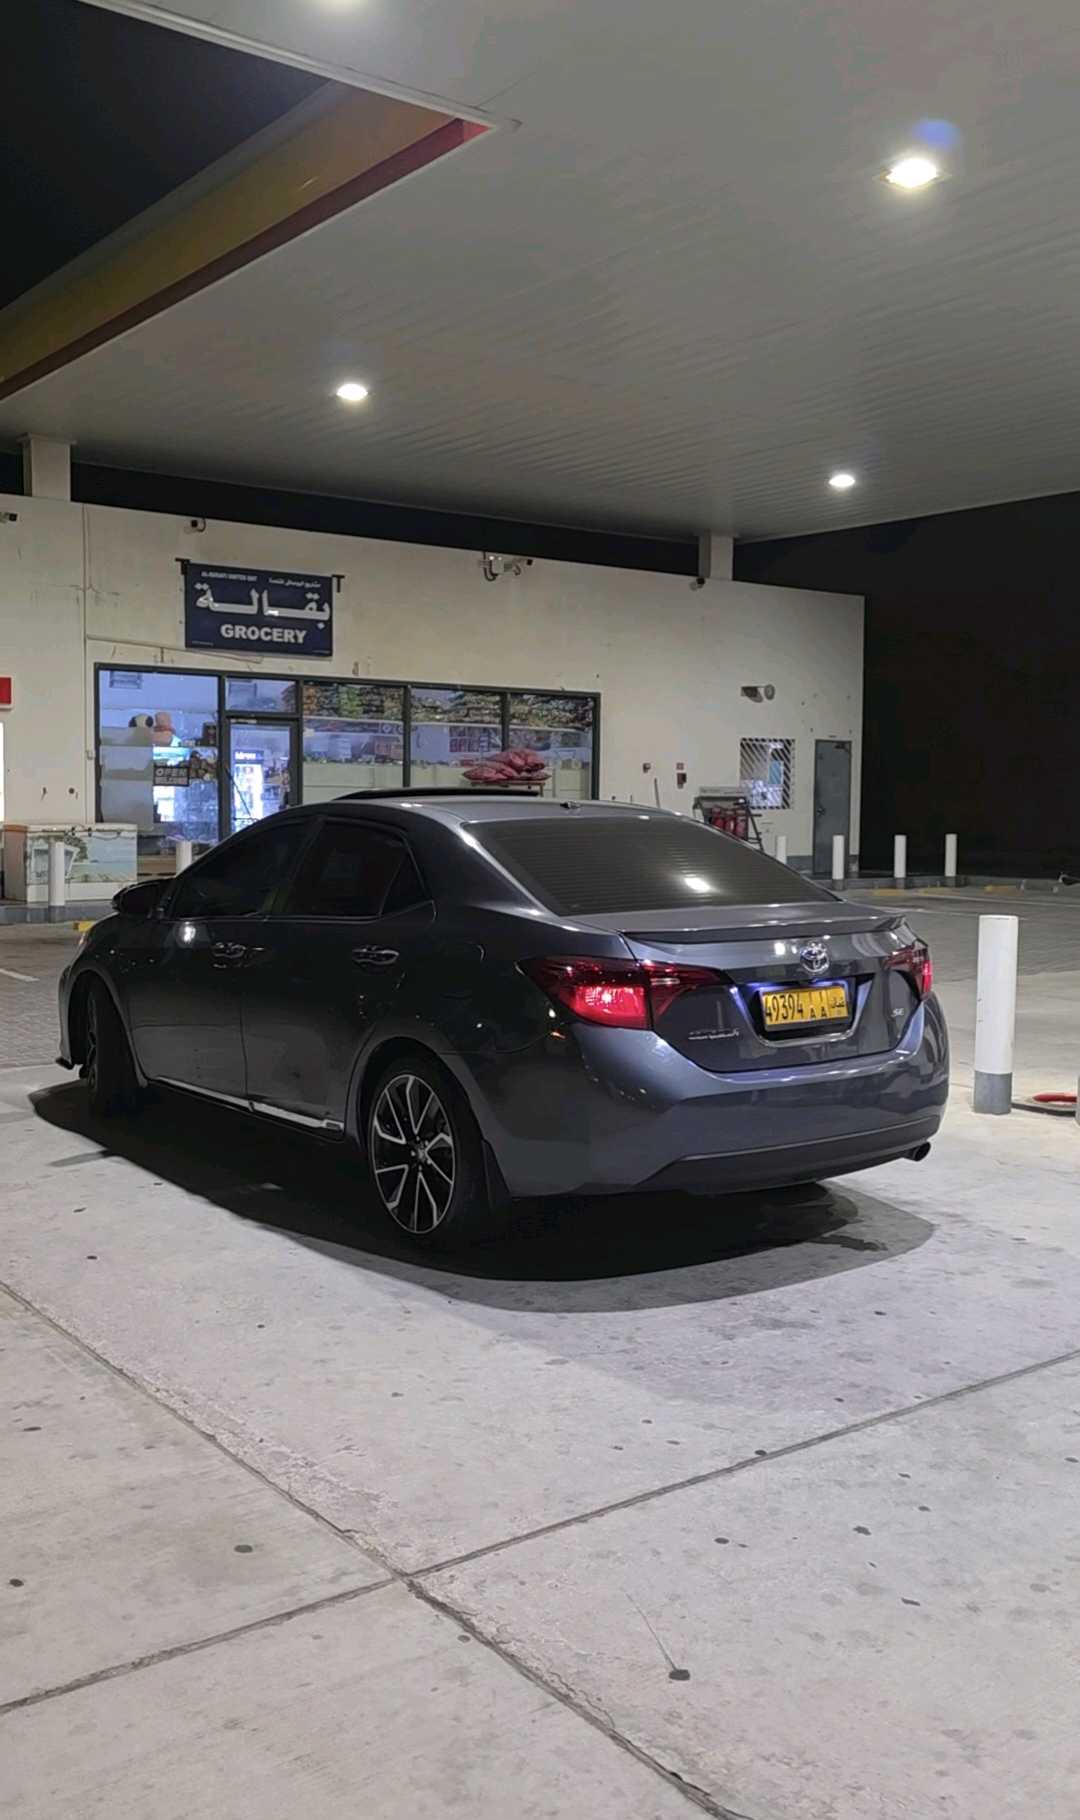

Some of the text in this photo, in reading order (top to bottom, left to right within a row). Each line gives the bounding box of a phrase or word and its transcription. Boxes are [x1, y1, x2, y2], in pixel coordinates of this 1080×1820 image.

[193, 581, 331, 630] بقالة
[220, 623, 307, 644] GROCERY
[155, 767, 188, 777] OPEN
[764, 990, 804, 1023] 49394
